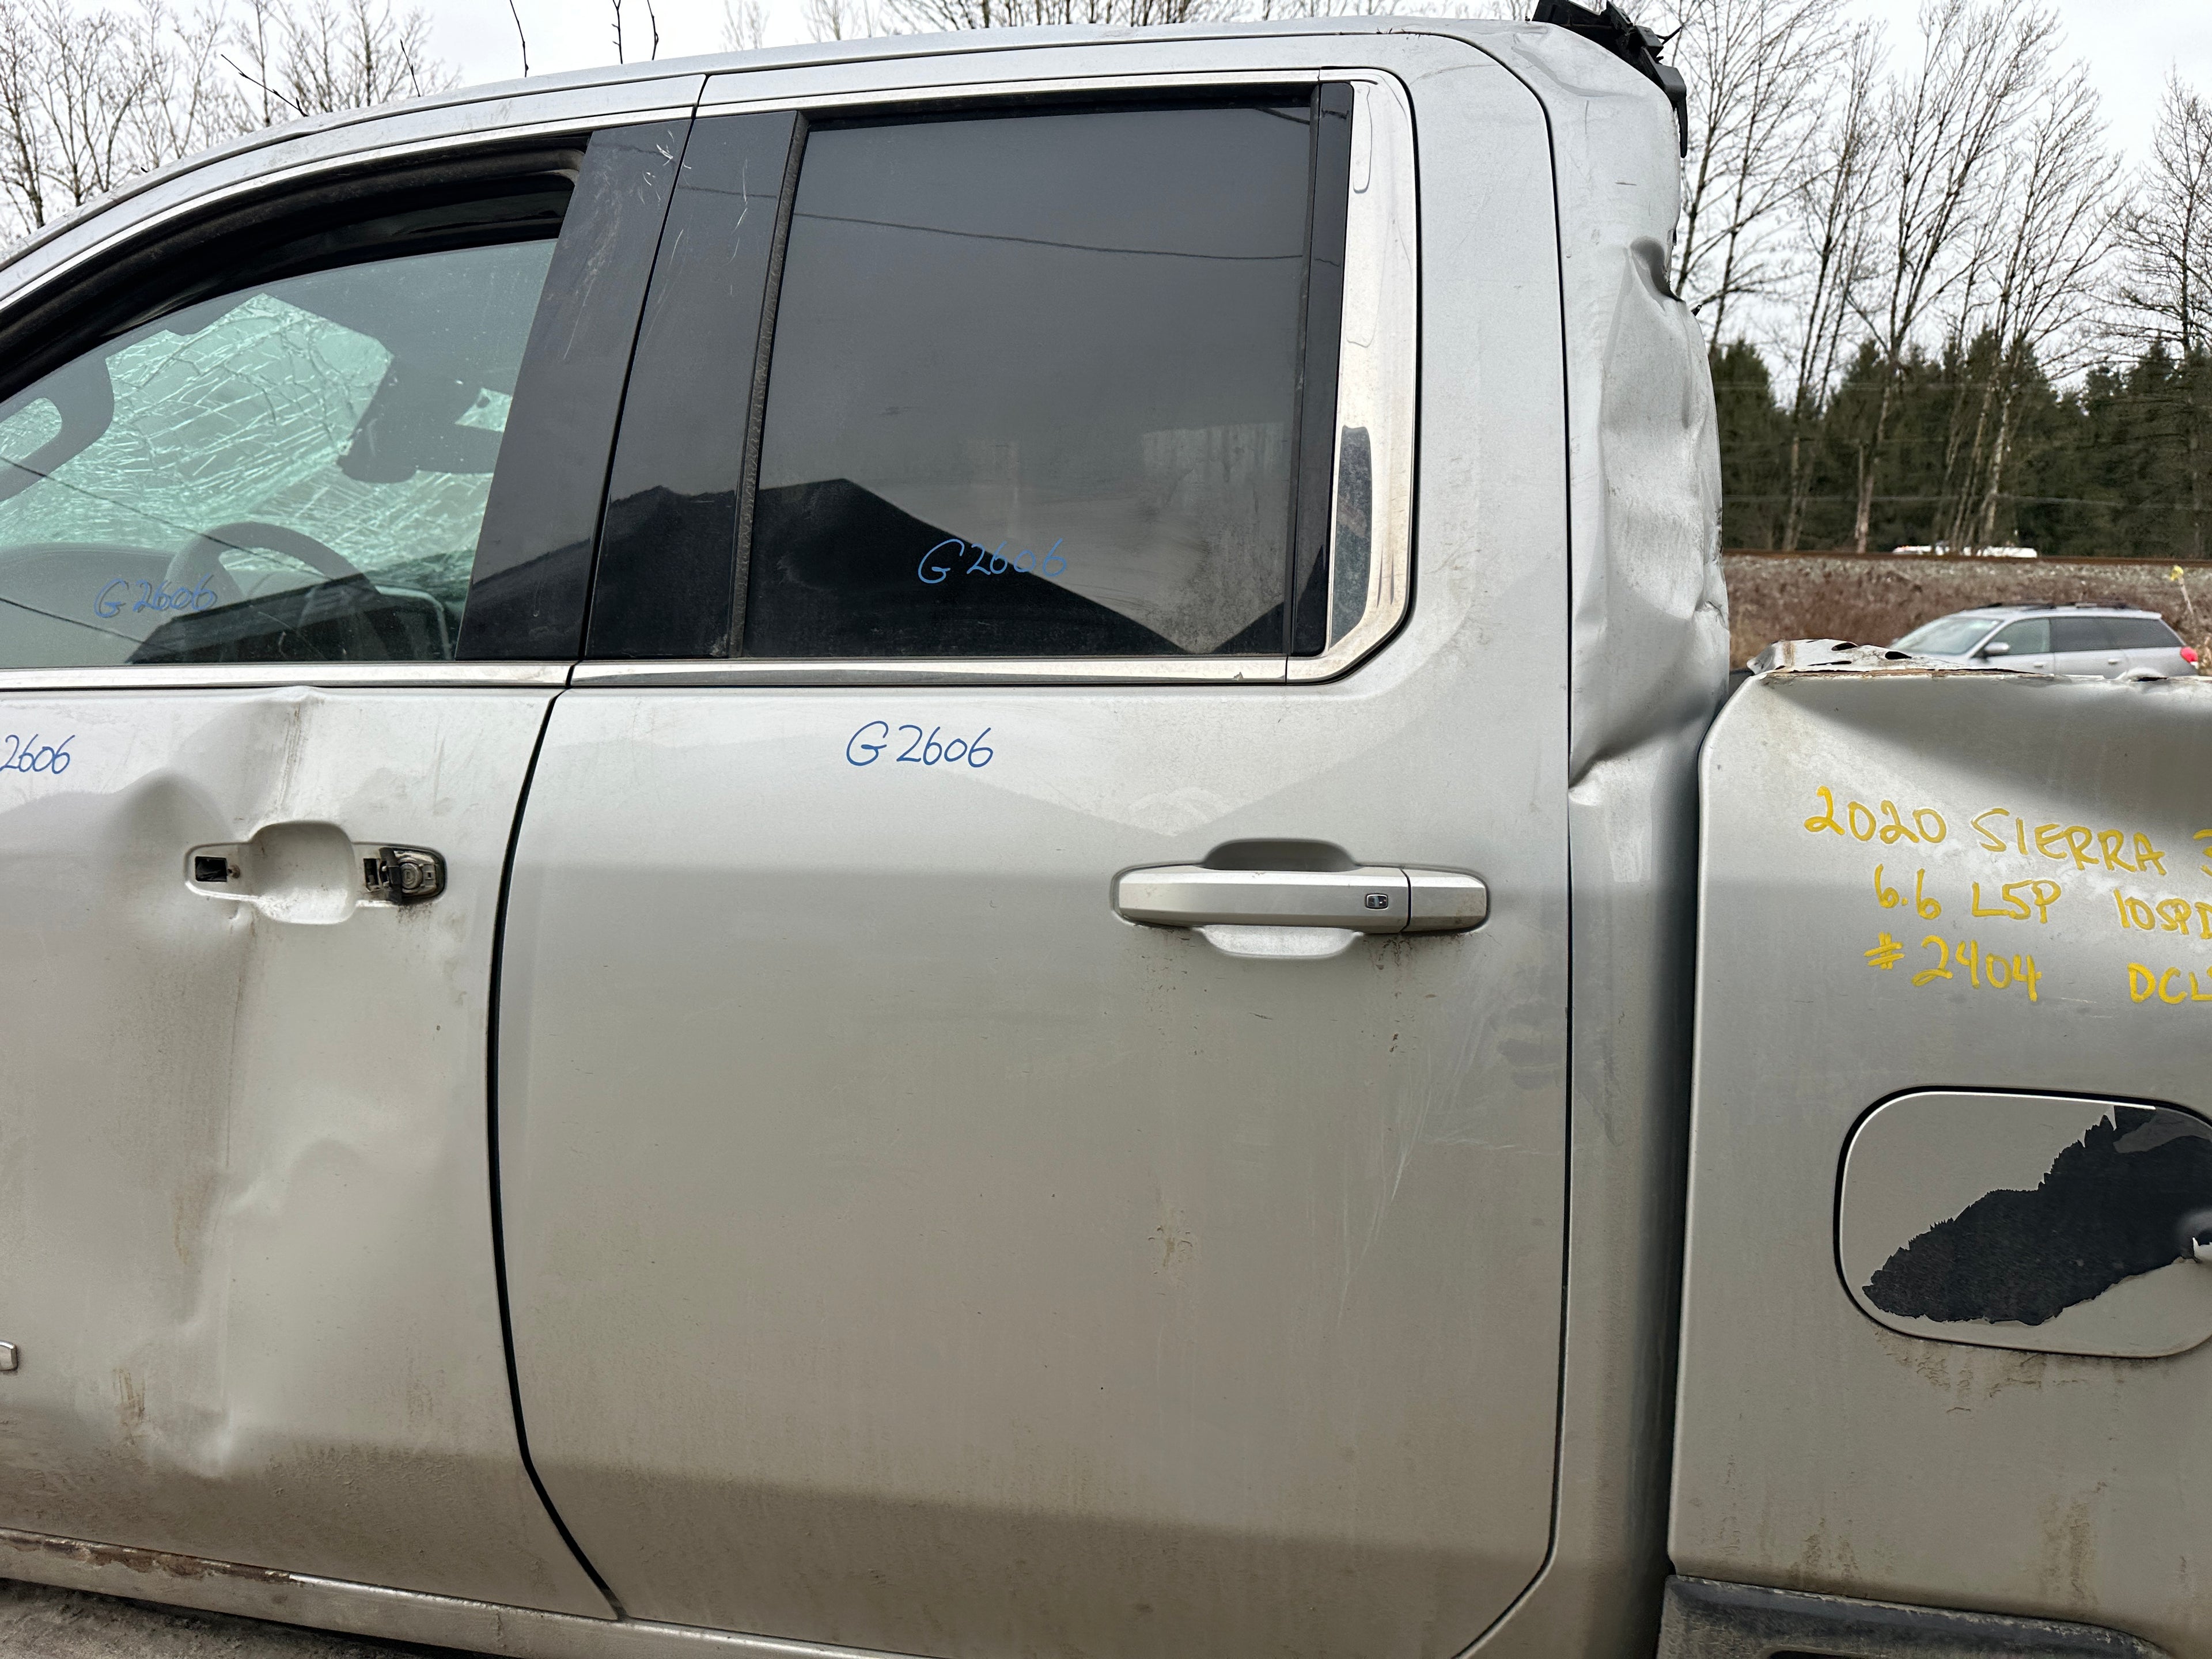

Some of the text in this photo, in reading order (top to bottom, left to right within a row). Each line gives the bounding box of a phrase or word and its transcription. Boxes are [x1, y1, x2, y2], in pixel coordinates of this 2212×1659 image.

[1804, 786, 1947, 844] 2020
[1971, 808, 2166, 876] SIERRA
[1874, 864, 1942, 920] 6.6
[1863, 931, 2212, 1005] #2404 DCL
